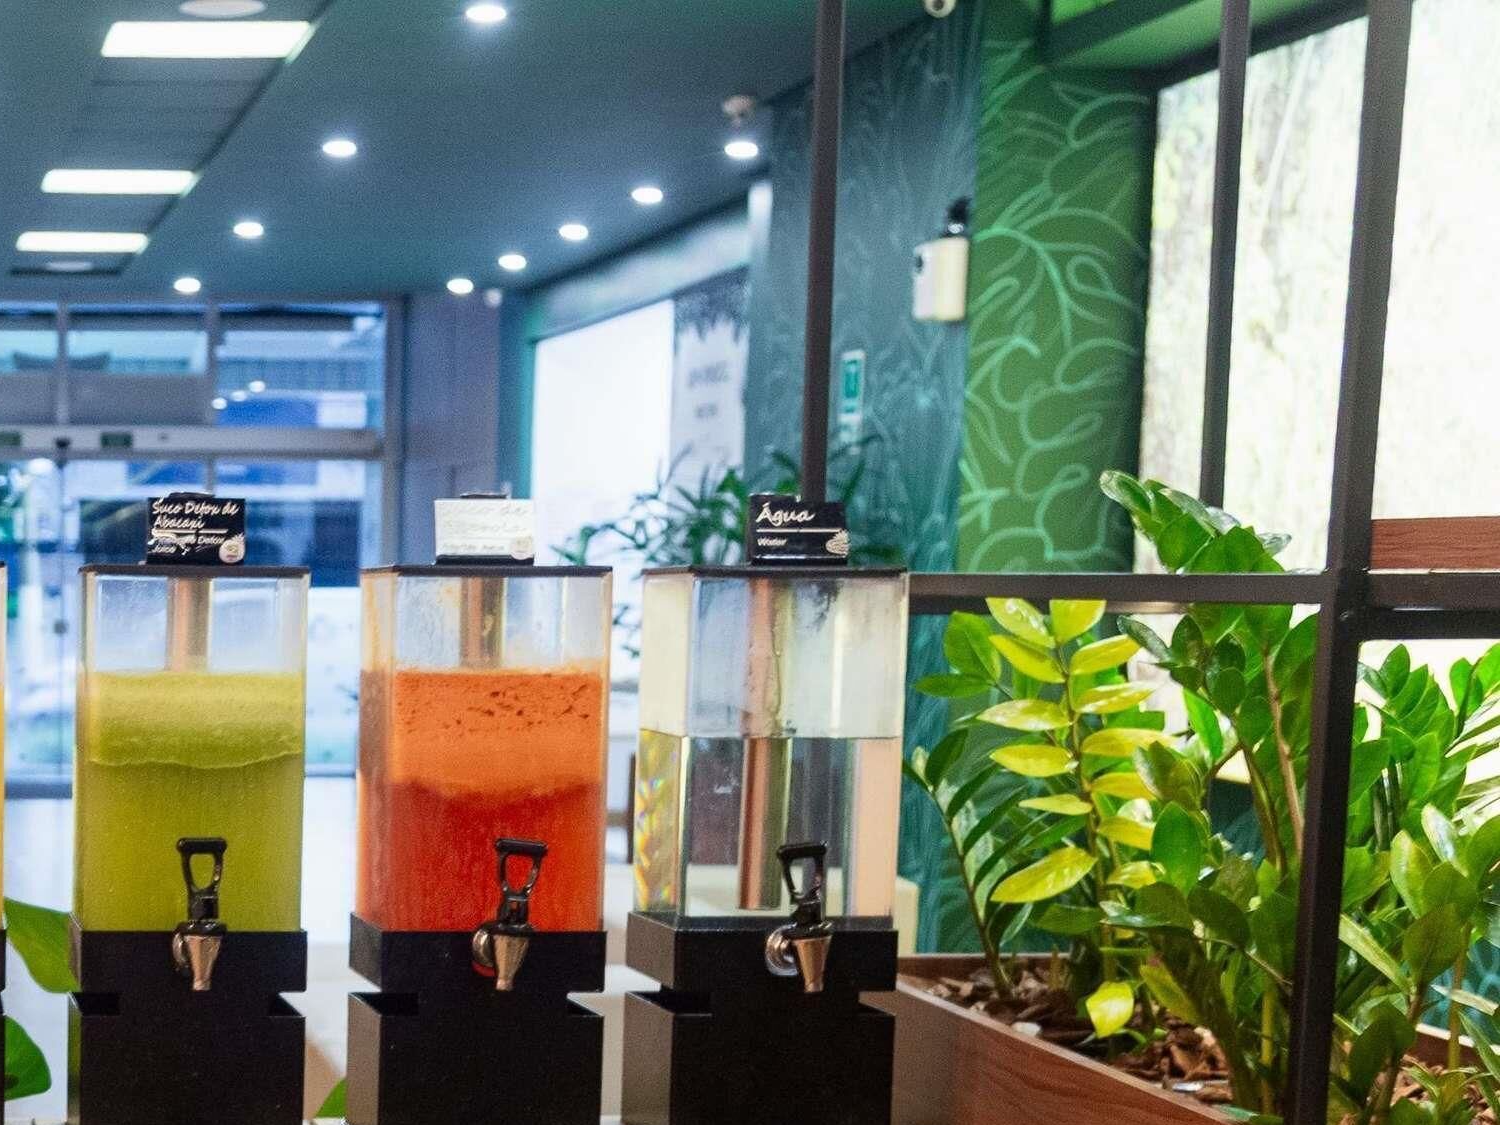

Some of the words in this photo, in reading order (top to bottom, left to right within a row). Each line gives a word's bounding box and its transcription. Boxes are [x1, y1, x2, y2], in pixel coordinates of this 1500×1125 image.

[152, 500, 182, 515] Suco
[185, 501, 221, 515] Detox
[221, 502, 240, 515] de
[755, 501, 816, 527] Água
[757, 538, 788, 547] Water
